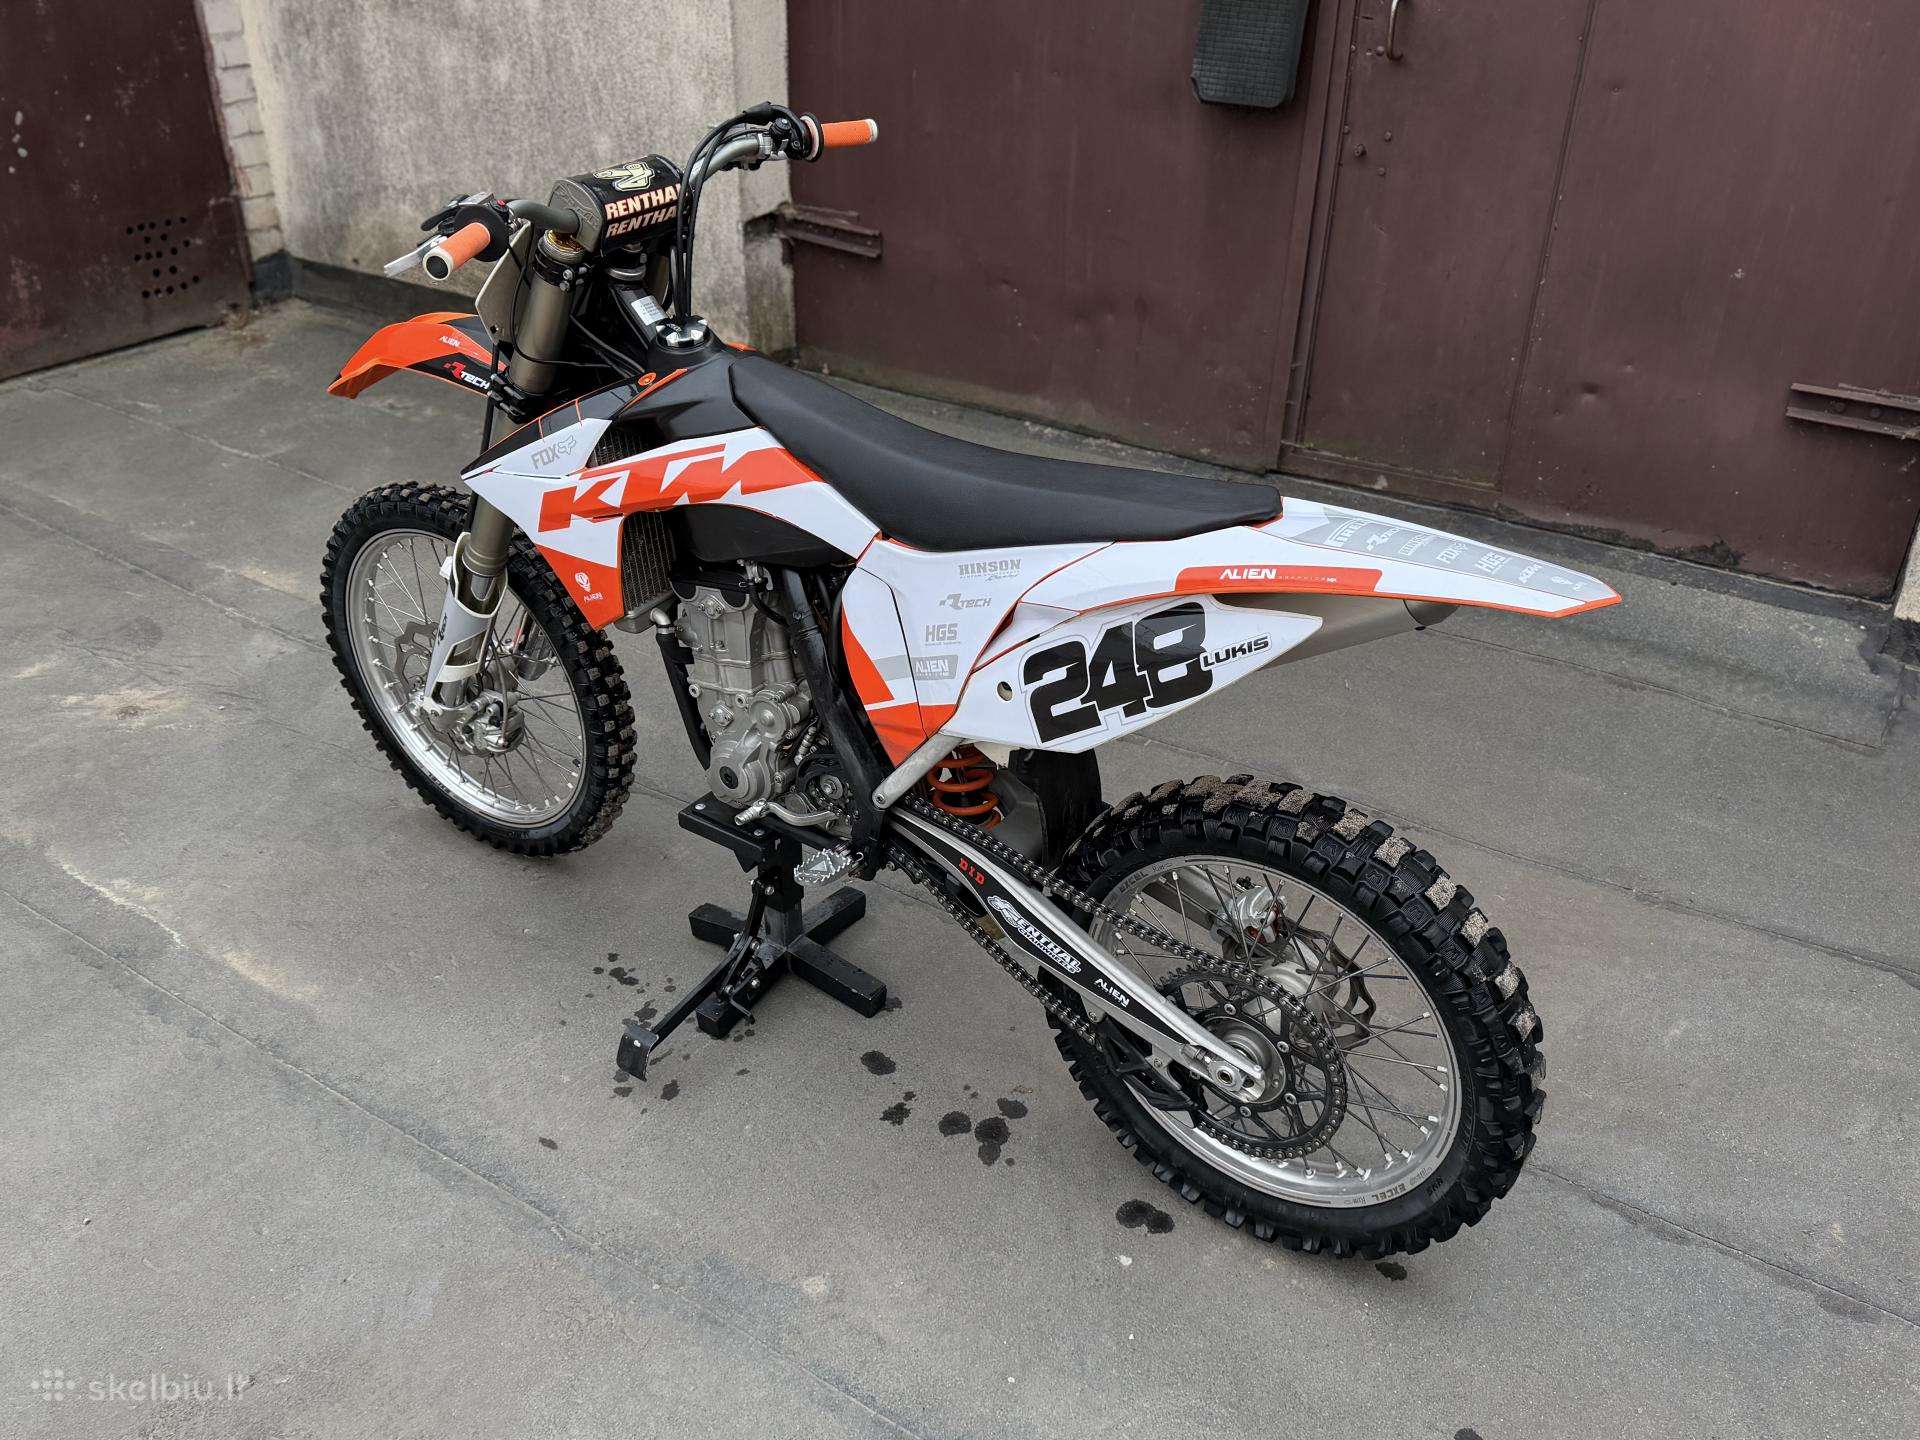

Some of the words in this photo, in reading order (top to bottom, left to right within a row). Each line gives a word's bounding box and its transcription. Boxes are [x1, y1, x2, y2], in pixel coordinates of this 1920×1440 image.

[605, 205, 678, 238] RENTHA
[531, 444, 560, 470] FOX
[538, 443, 826, 533] KTM
[958, 559, 1022, 576] HINSON
[1219, 568, 1277, 580] ALIEN
[925, 623, 958, 642] HGS
[1203, 635, 1269, 668] LUKIS
[915, 659, 950, 673] ALIEN
[1023, 602, 1214, 743] 248
[1094, 977, 1130, 1007] ALIEN
[1371, 1184, 1407, 1201] EXCEL
